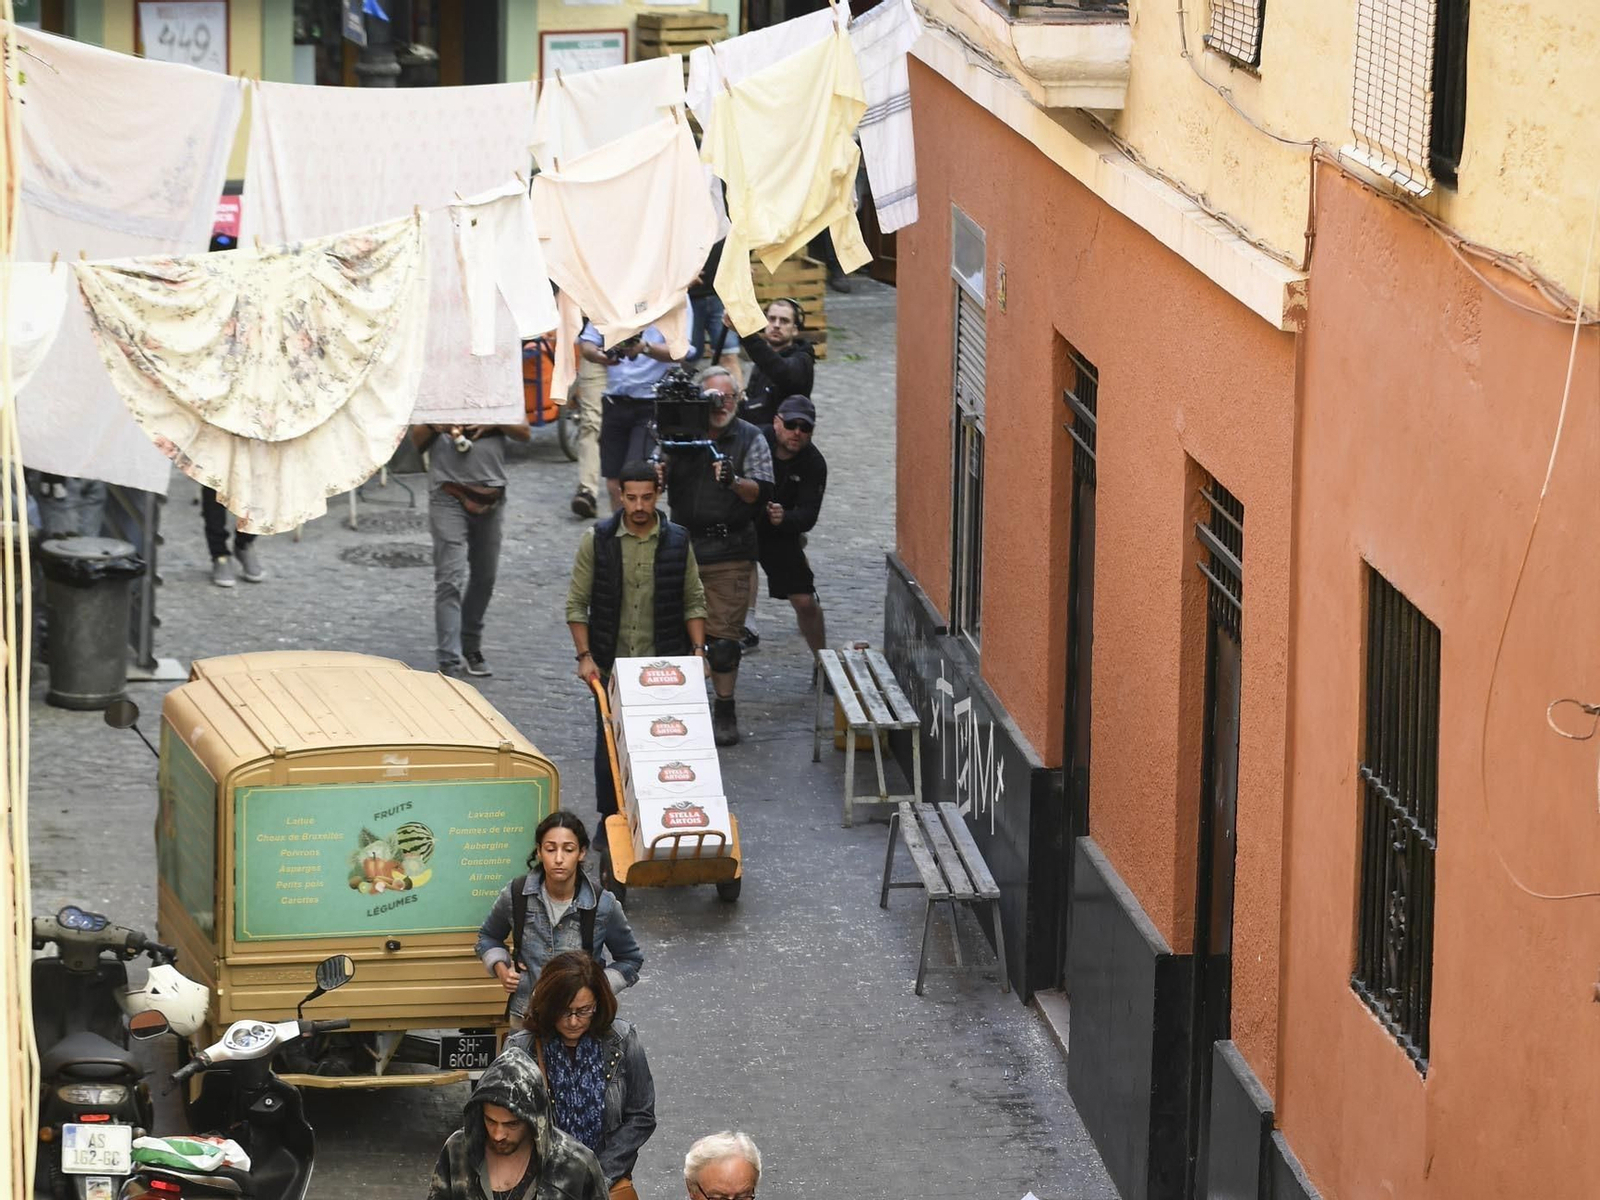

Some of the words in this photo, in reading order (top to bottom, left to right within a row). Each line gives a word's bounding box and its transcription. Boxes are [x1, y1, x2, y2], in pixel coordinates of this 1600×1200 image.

[374, 800, 412, 821] FRUITS
[468, 810, 506, 819] Lavande
[448, 827, 486, 835] Pommes
[366, 894, 418, 917] LÉGUMES
